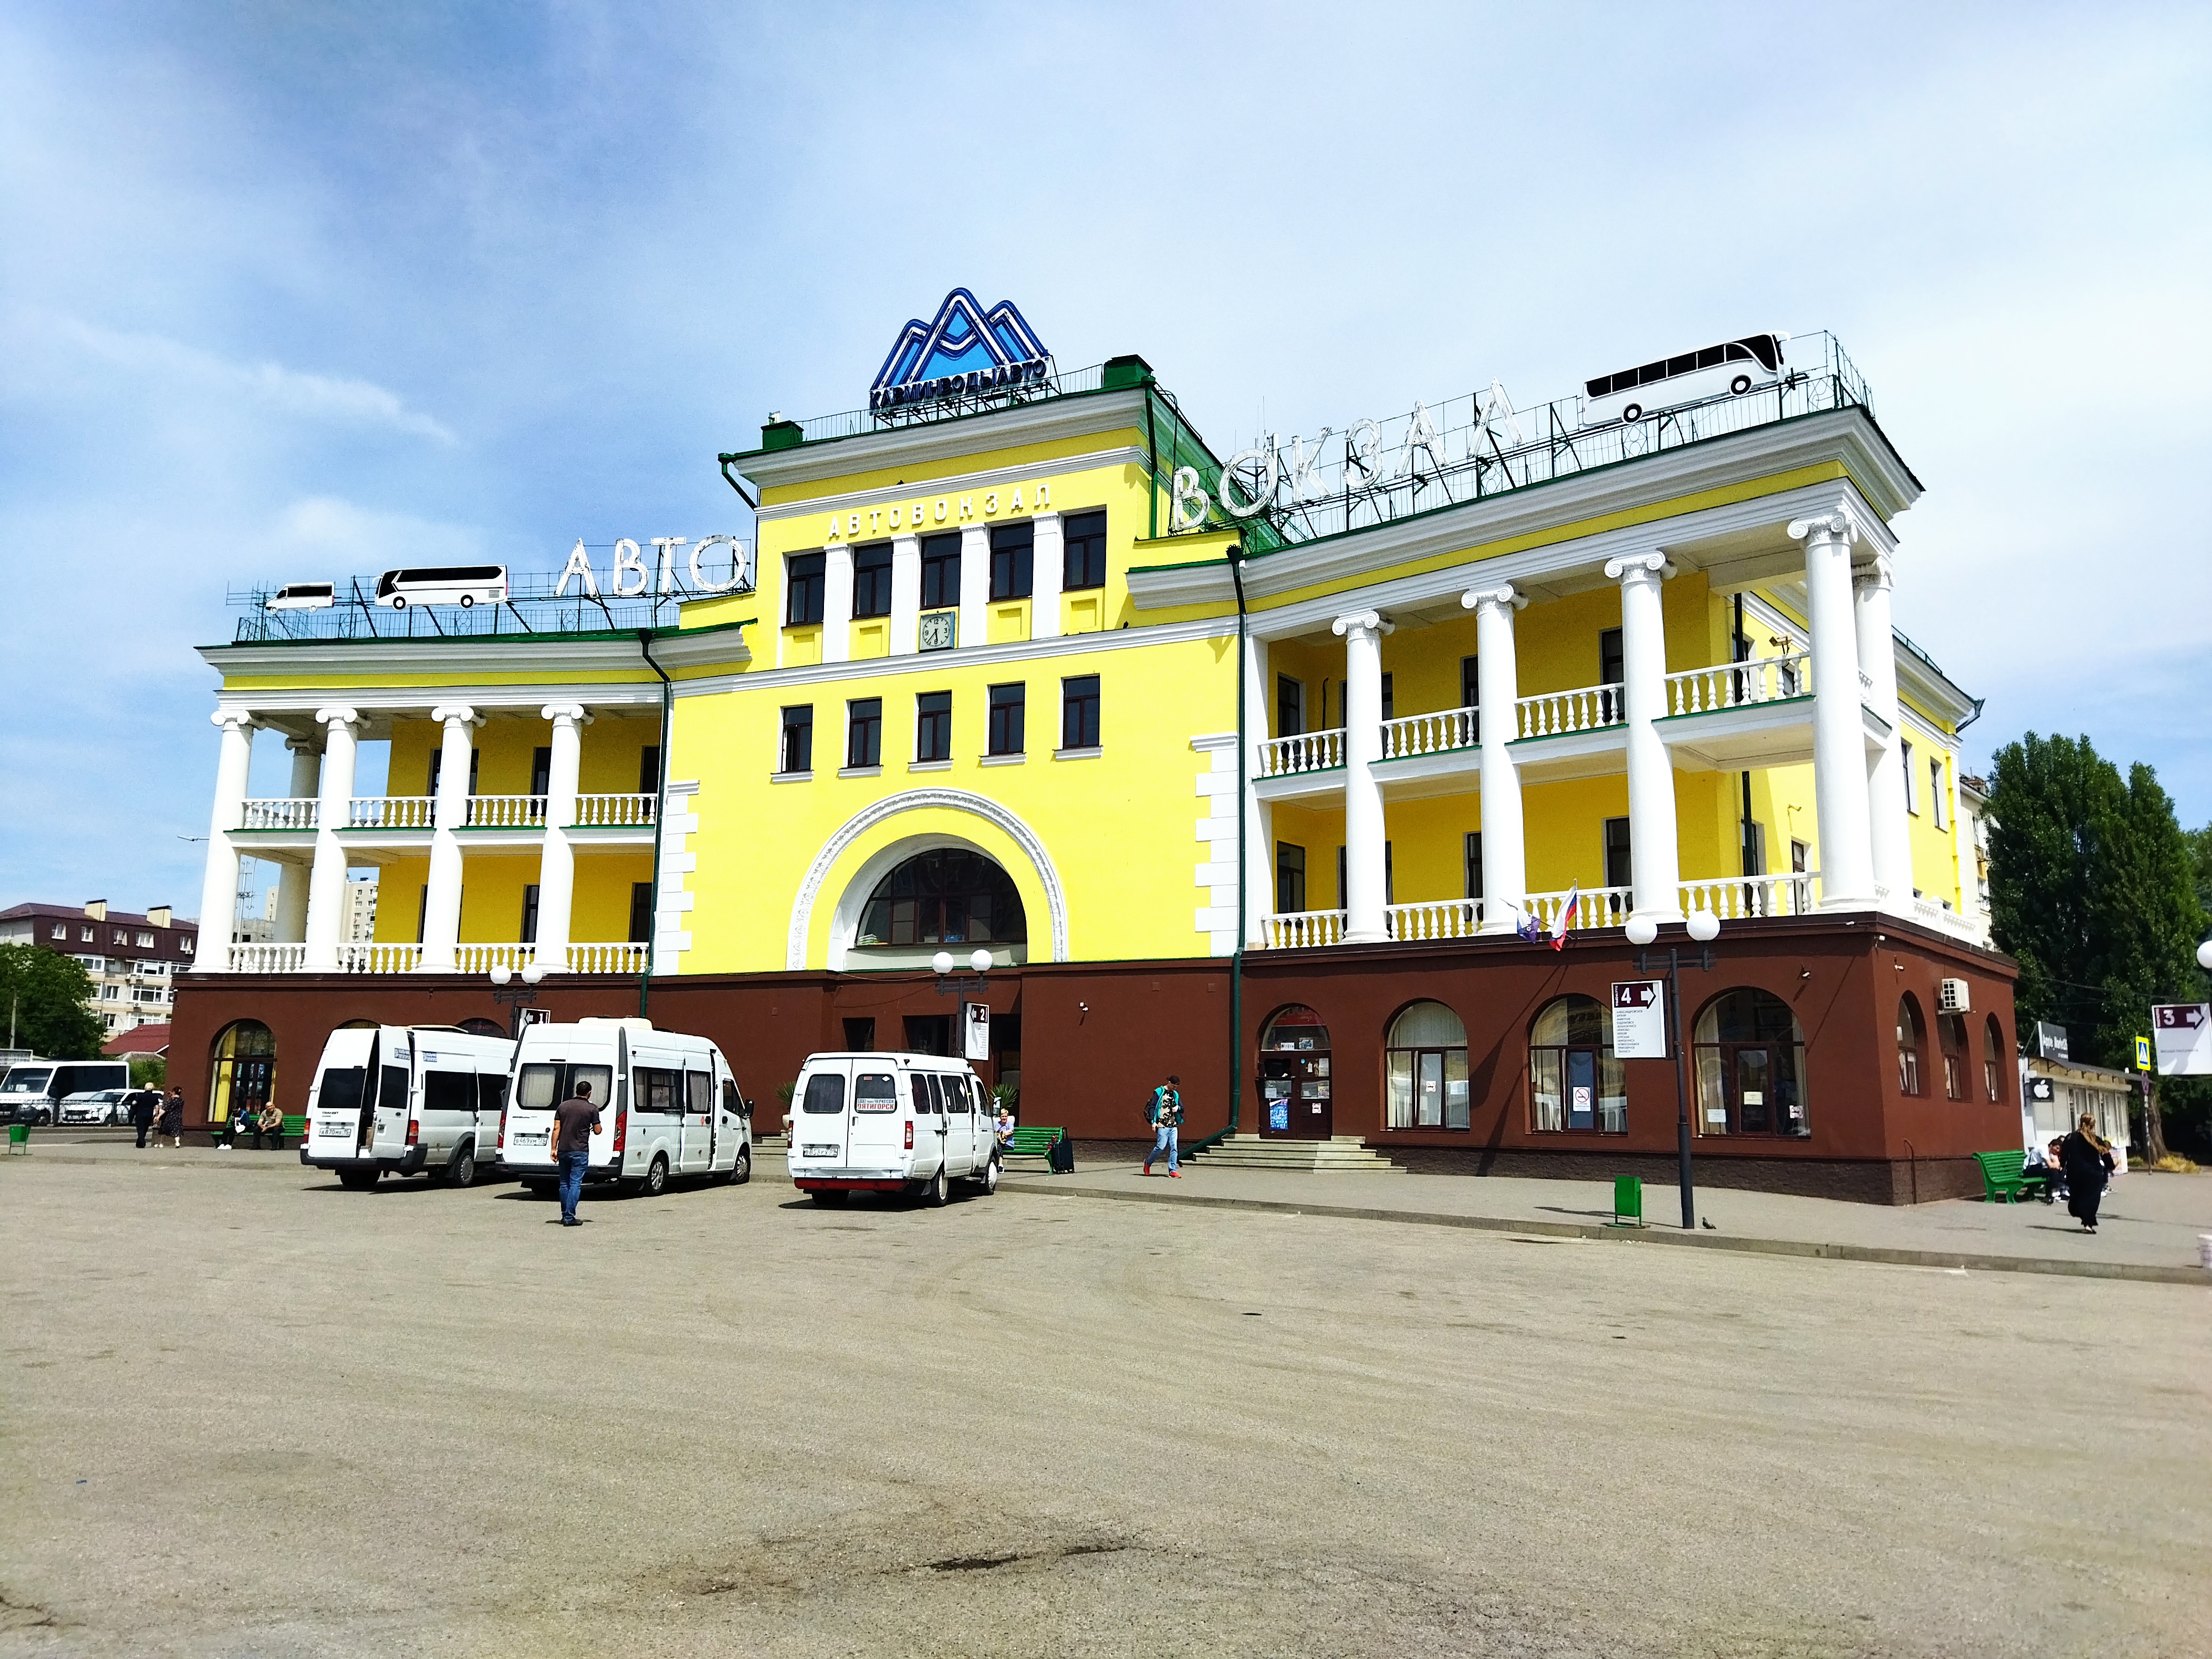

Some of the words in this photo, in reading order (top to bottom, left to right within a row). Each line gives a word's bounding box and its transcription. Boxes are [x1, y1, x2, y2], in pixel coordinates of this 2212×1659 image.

[869, 359, 1047, 410] КАВМИНВОДЫАВТО
[1172, 376, 1526, 532] ВОКЗАЛ
[828, 483, 1051, 539] АВТОВОКЗАЛ
[554, 534, 747, 598] АВТО
[1621, 987, 1631, 1004] 4
[539, 1013, 544, 1024] 1
[980, 1008, 985, 1021] 2
[2163, 1009, 2175, 1025] 3
